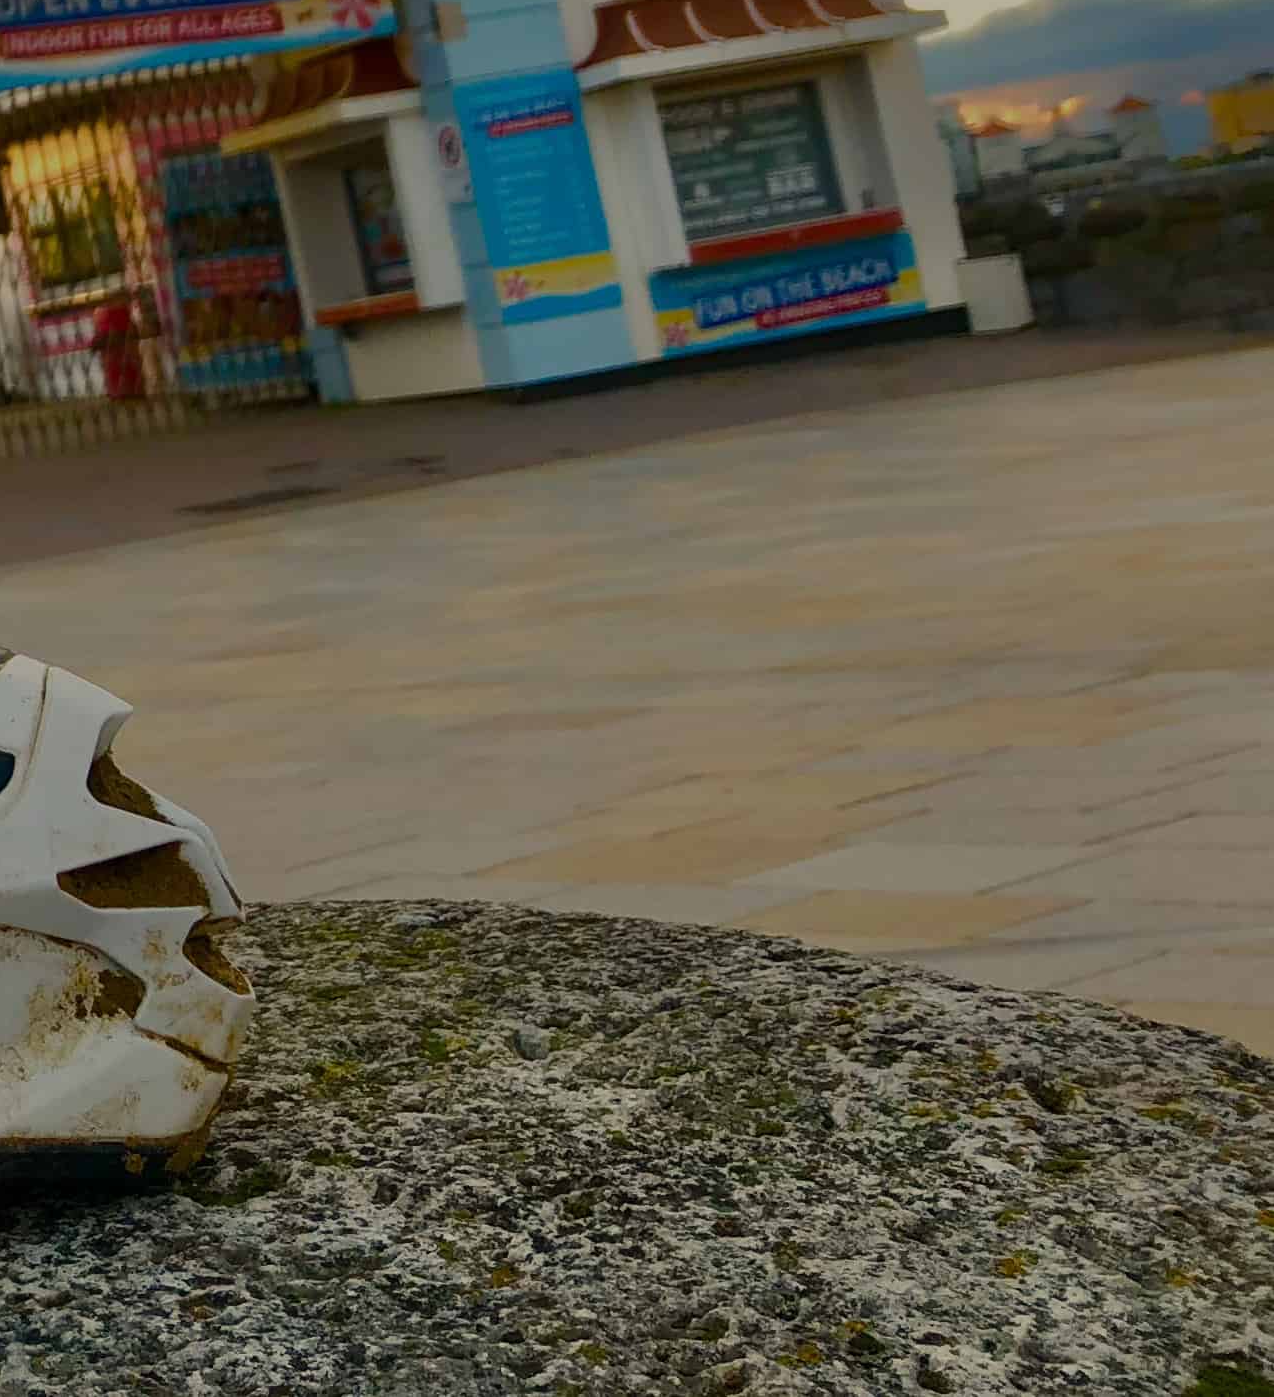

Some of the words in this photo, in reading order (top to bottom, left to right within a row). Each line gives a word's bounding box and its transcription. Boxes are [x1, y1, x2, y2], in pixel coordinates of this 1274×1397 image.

[3, 25, 84, 55] INDOOR
[88, 23, 129, 49] FUN
[133, 17, 173, 43] FOR
[178, 13, 216, 38] ALL
[219, 6, 278, 34] AGES
